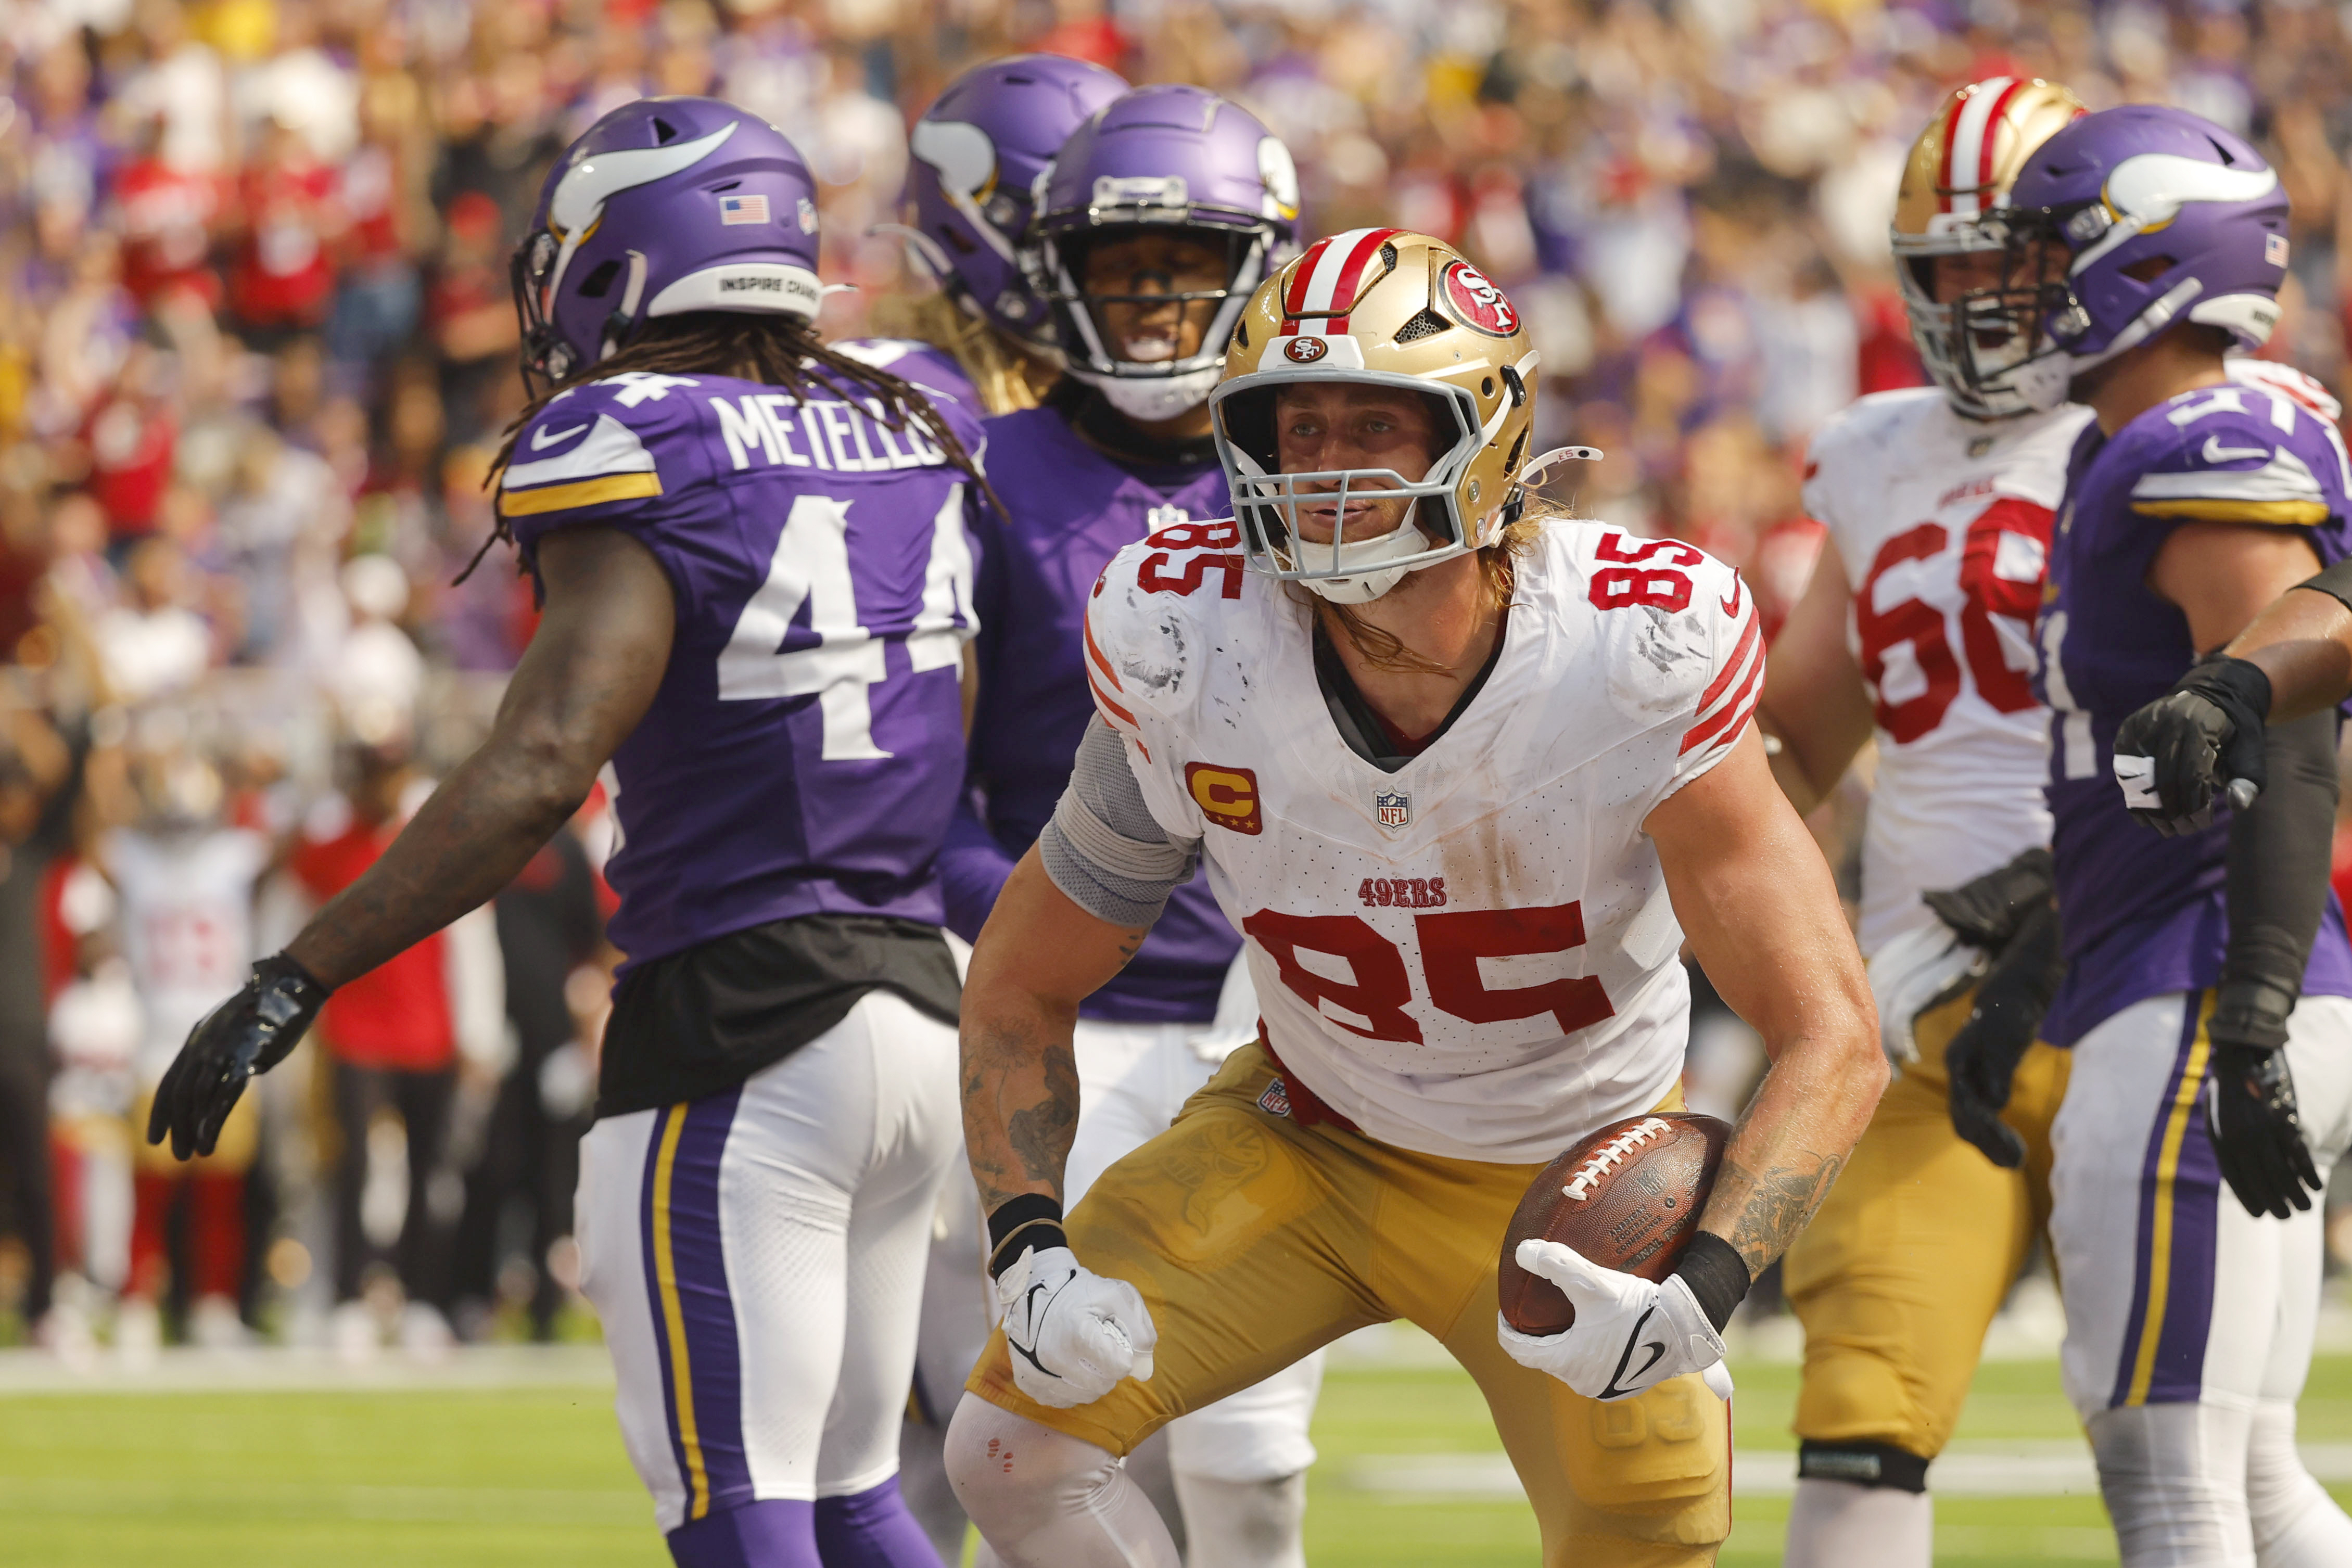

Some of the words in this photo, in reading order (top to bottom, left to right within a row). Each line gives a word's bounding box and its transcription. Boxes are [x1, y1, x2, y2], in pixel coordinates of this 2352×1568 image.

[720, 277, 782, 292] INSPIRE
[1295, 339, 1319, 359] SF
[1138, 520, 1245, 600] 85
[1587, 532, 1705, 614] 85
[716, 482, 982, 761] 44
[1191, 769, 1254, 818] C
[1380, 807, 1406, 825] NFL
[1357, 877, 1447, 908] 49ERS
[1242, 899, 1617, 1047] 85
[1262, 1093, 1289, 1112] NFL
[1609, 1205, 1647, 1236] AMERICAN
[1615, 1213, 1654, 1244] FOOTBALL
[1616, 1216, 1663, 1255] CONFERENCE
